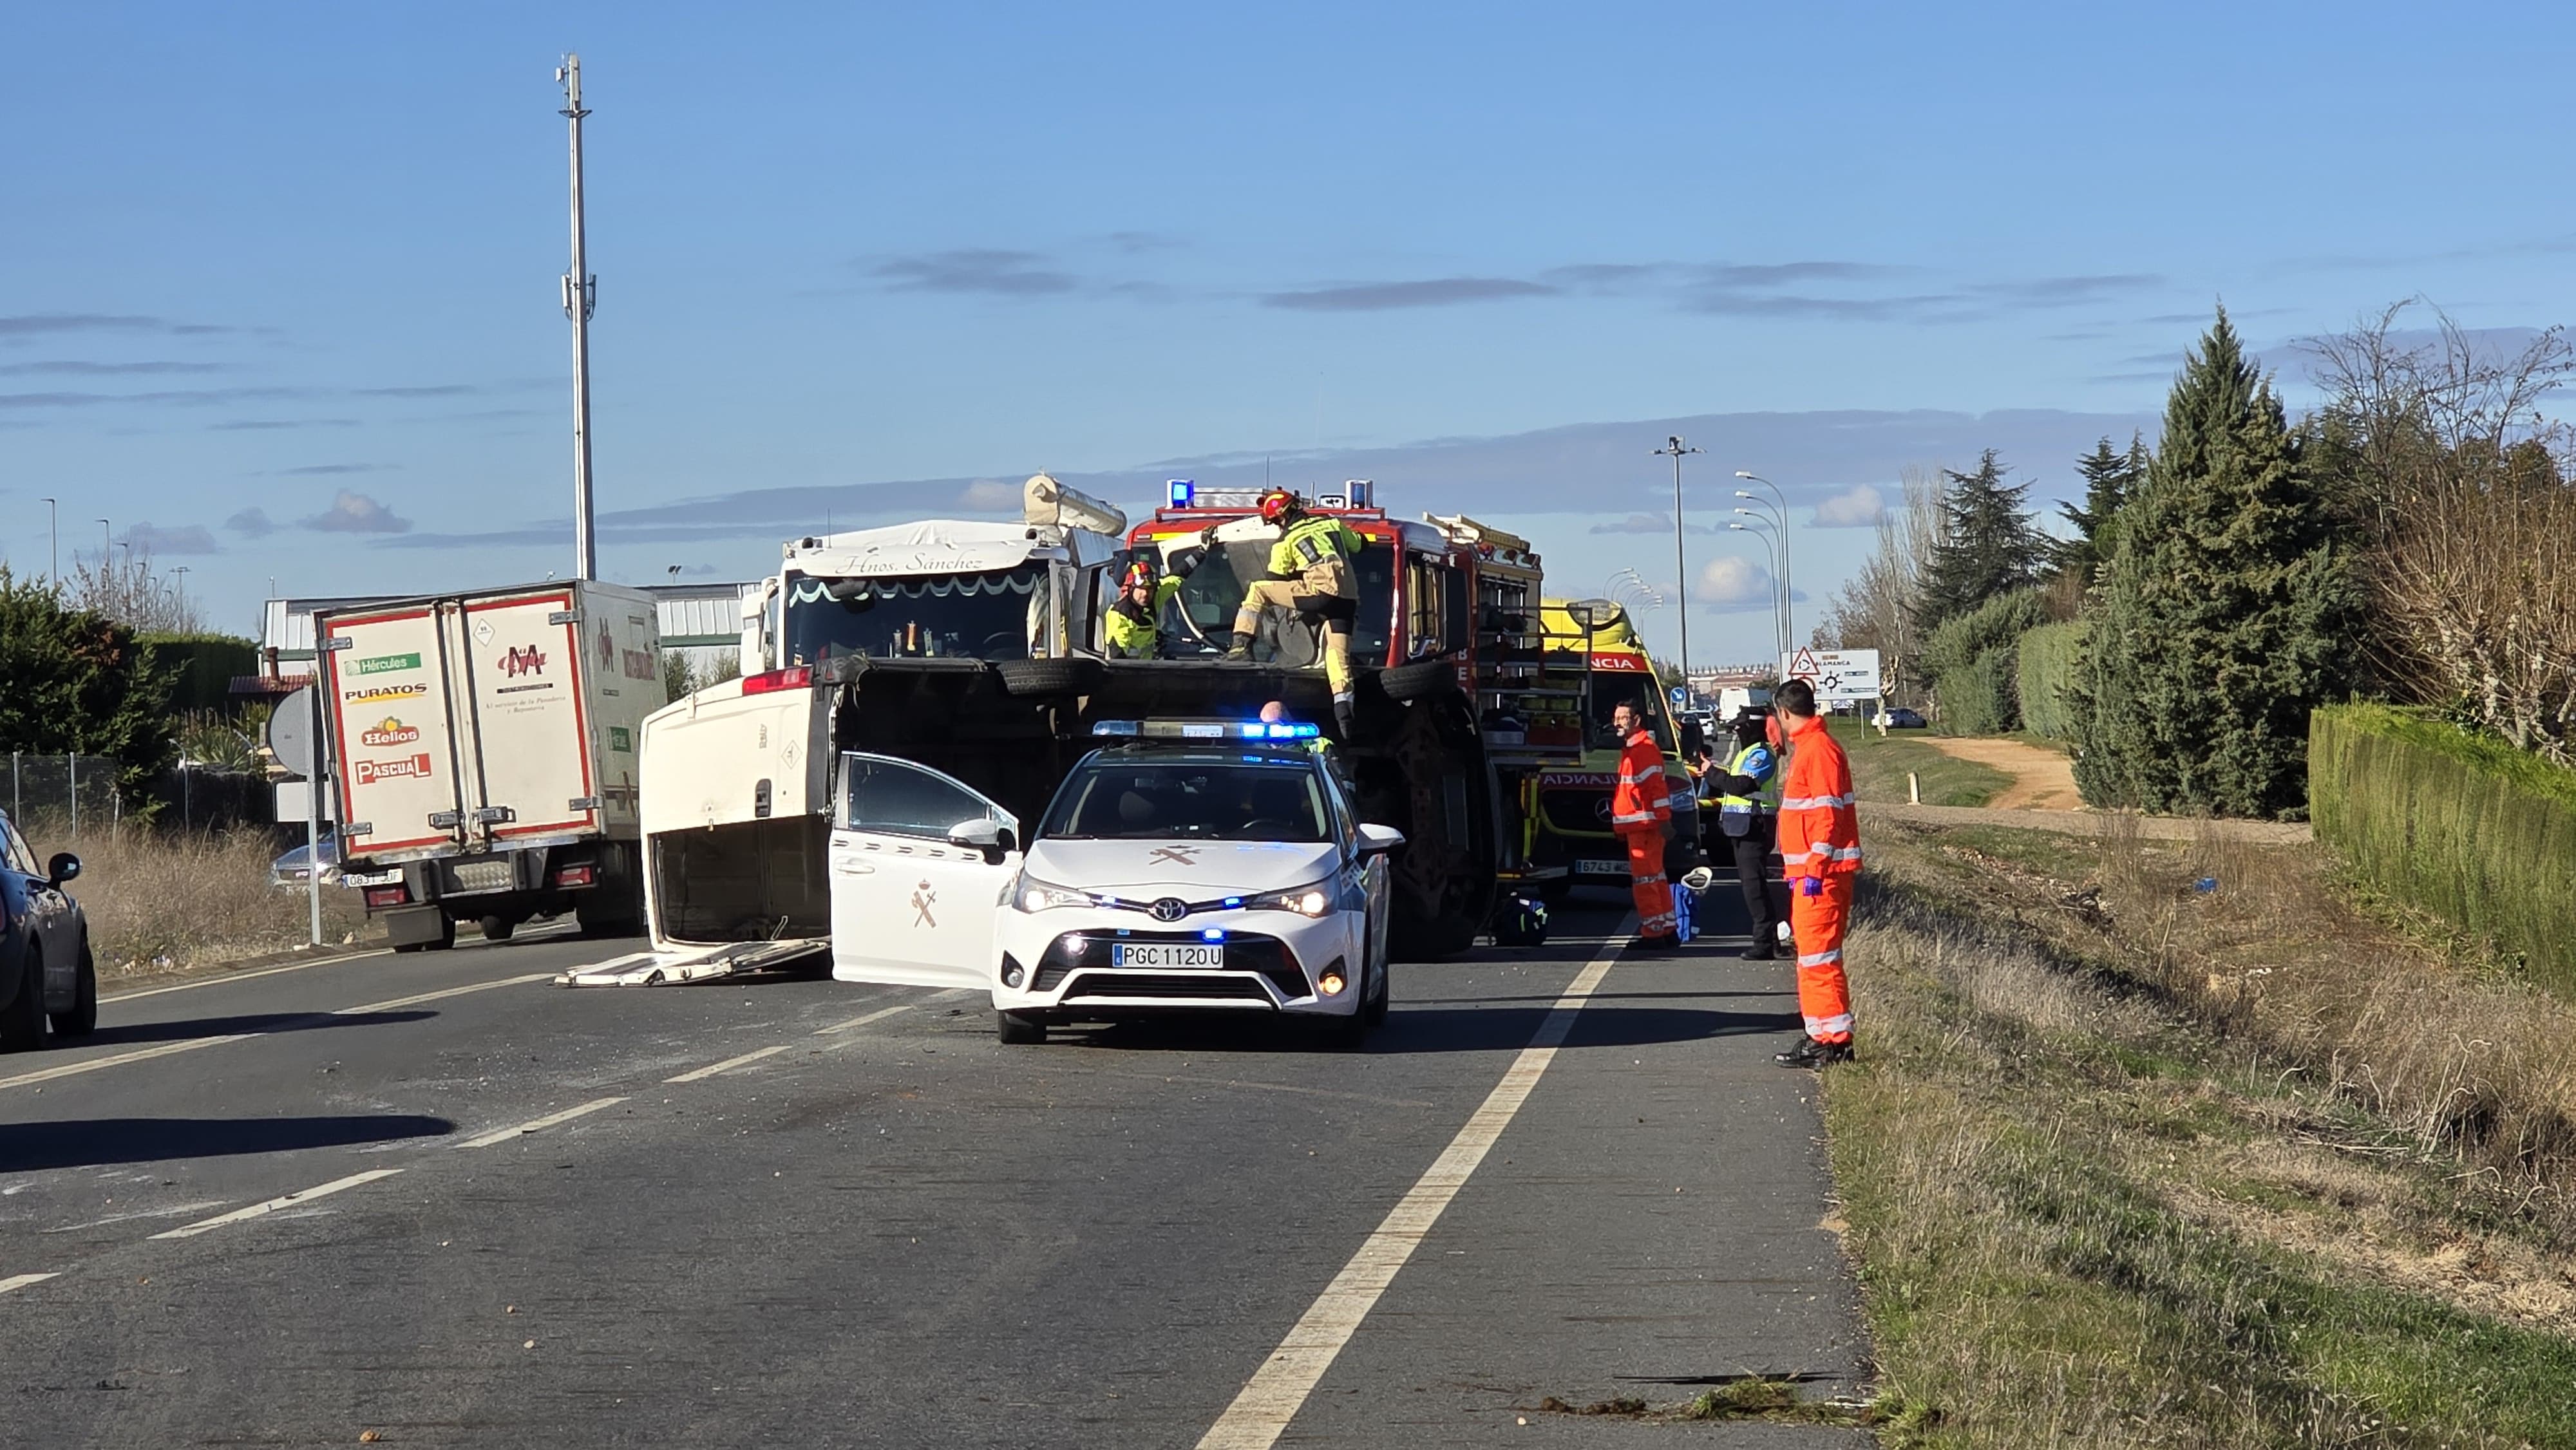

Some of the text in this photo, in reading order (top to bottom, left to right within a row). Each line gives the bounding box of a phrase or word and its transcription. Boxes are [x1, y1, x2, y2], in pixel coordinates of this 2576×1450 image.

[835, 554, 898, 574] Hnos.
[1591, 658, 1635, 669] NCIA
[345, 683, 427, 700] PURATOS
[365, 731, 417, 744] Helios
